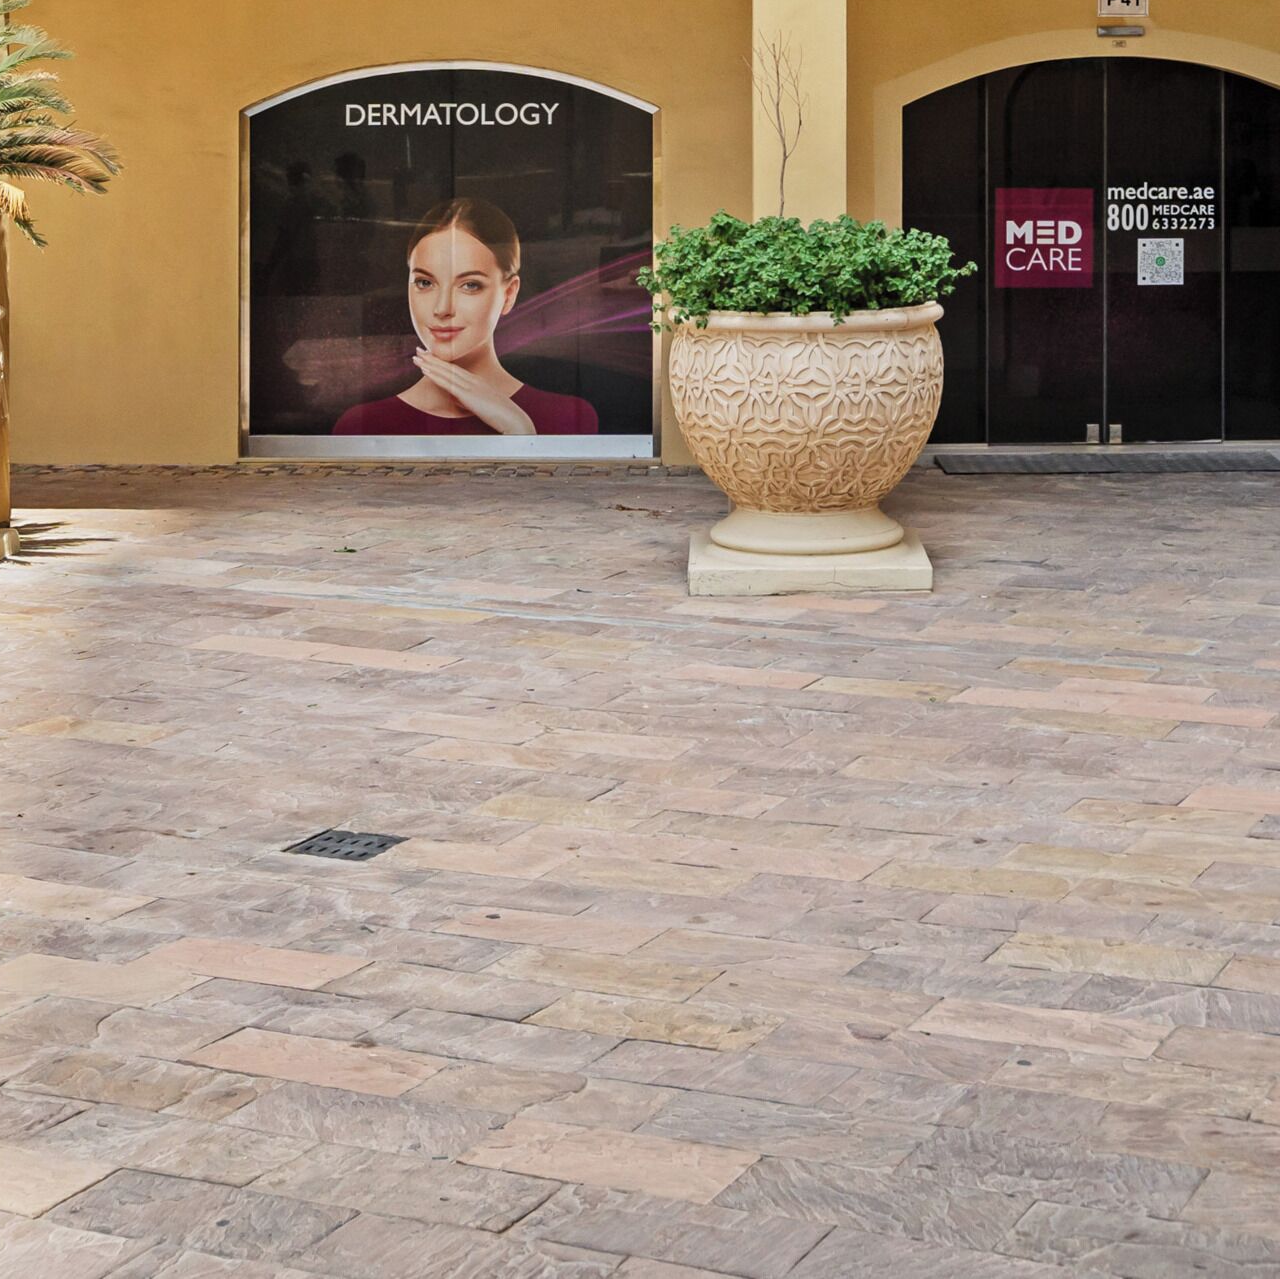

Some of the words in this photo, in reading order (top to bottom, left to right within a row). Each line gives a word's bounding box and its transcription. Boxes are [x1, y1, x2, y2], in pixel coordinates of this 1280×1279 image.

[345, 103, 560, 126] DERMATOLOGY
[1107, 182, 1215, 200] medcare.ae
[1107, 203, 1149, 231] 800
[1152, 204, 1215, 216] MEDCARE
[1006, 220, 1083, 245] MED
[1152, 217, 1215, 230] 6332273
[1006, 248, 1082, 272] CARE
